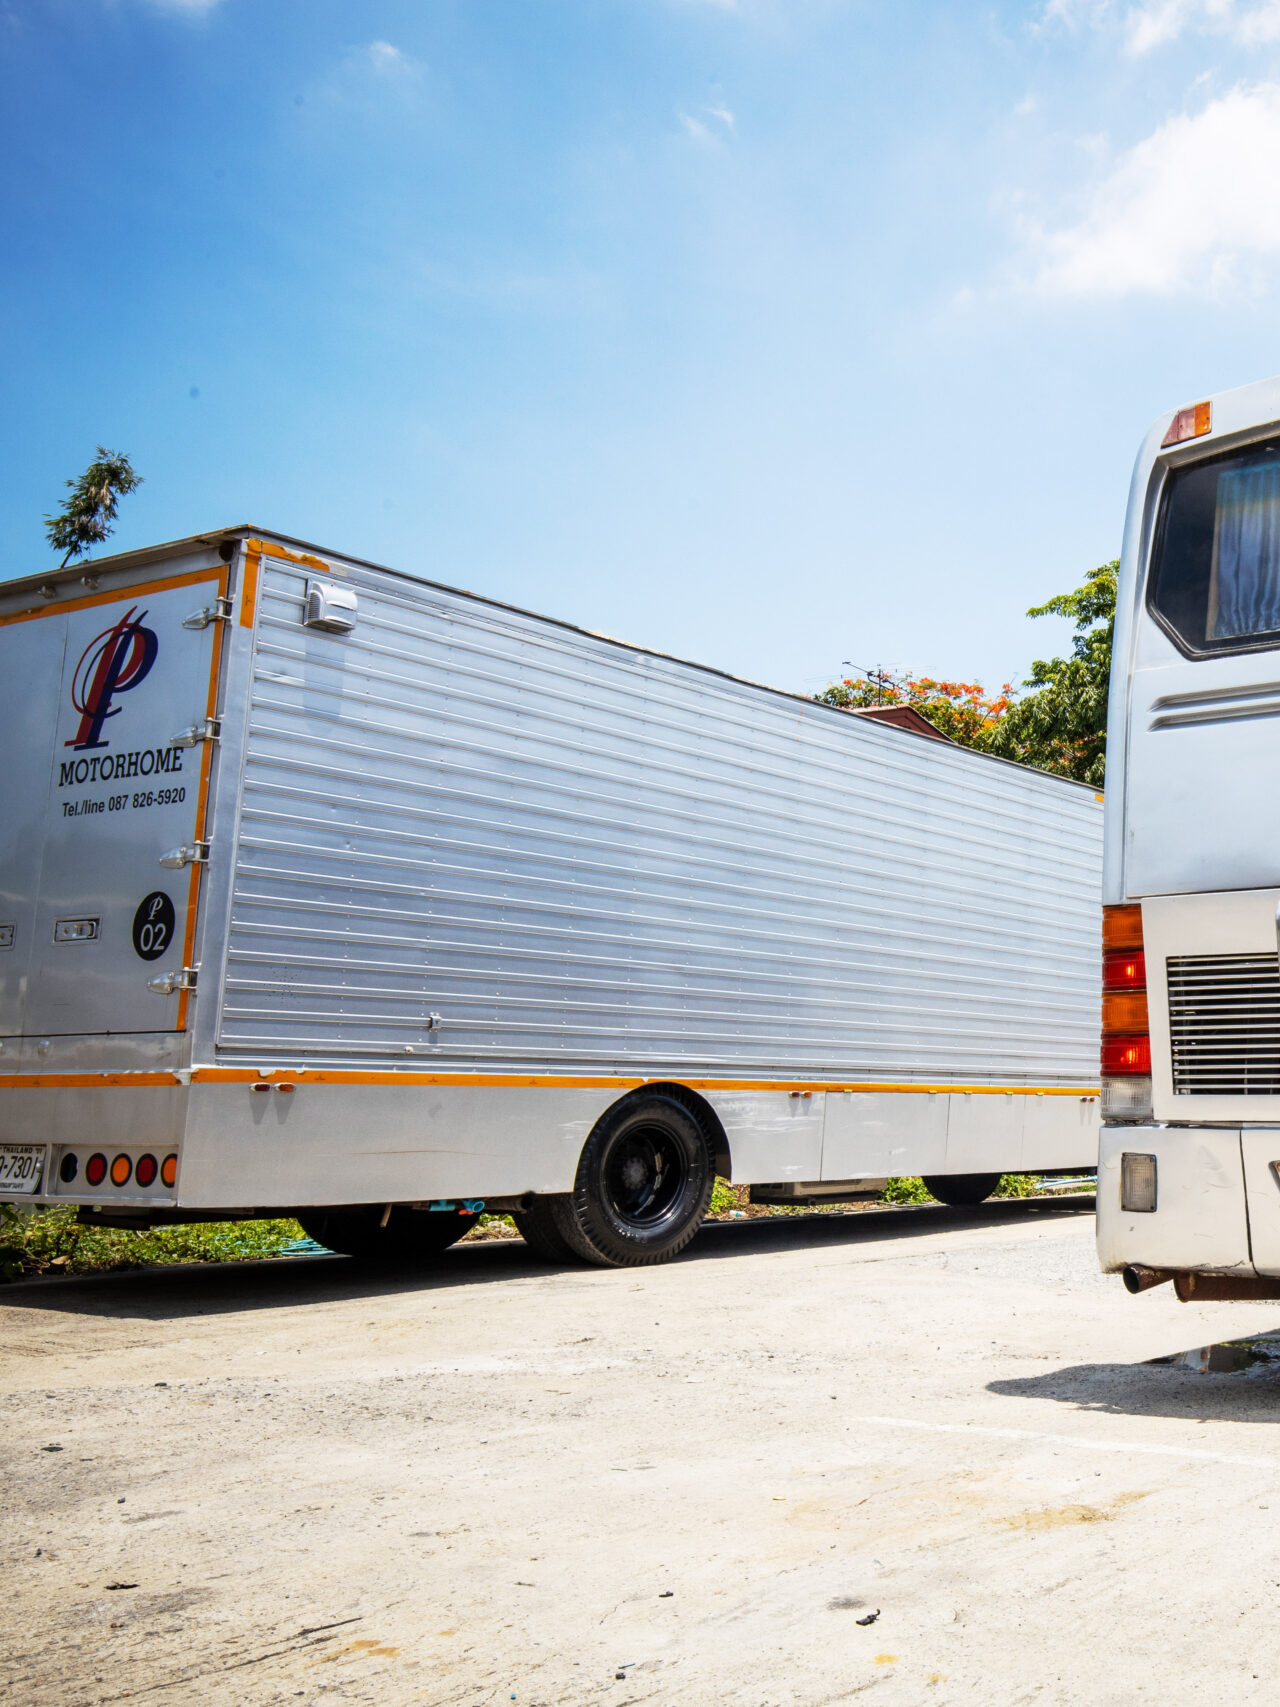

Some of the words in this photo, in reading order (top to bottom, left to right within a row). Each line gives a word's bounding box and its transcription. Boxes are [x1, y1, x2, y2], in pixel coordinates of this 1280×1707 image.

[58, 746, 184, 787] MOTORHOME
[62, 798, 105, 817] Tel./line
[108, 794, 129, 812] 087
[132, 787, 186, 809] 826-5920
[140, 923, 166, 951] 02
[3, 1146, 33, 1154] THAILAND
